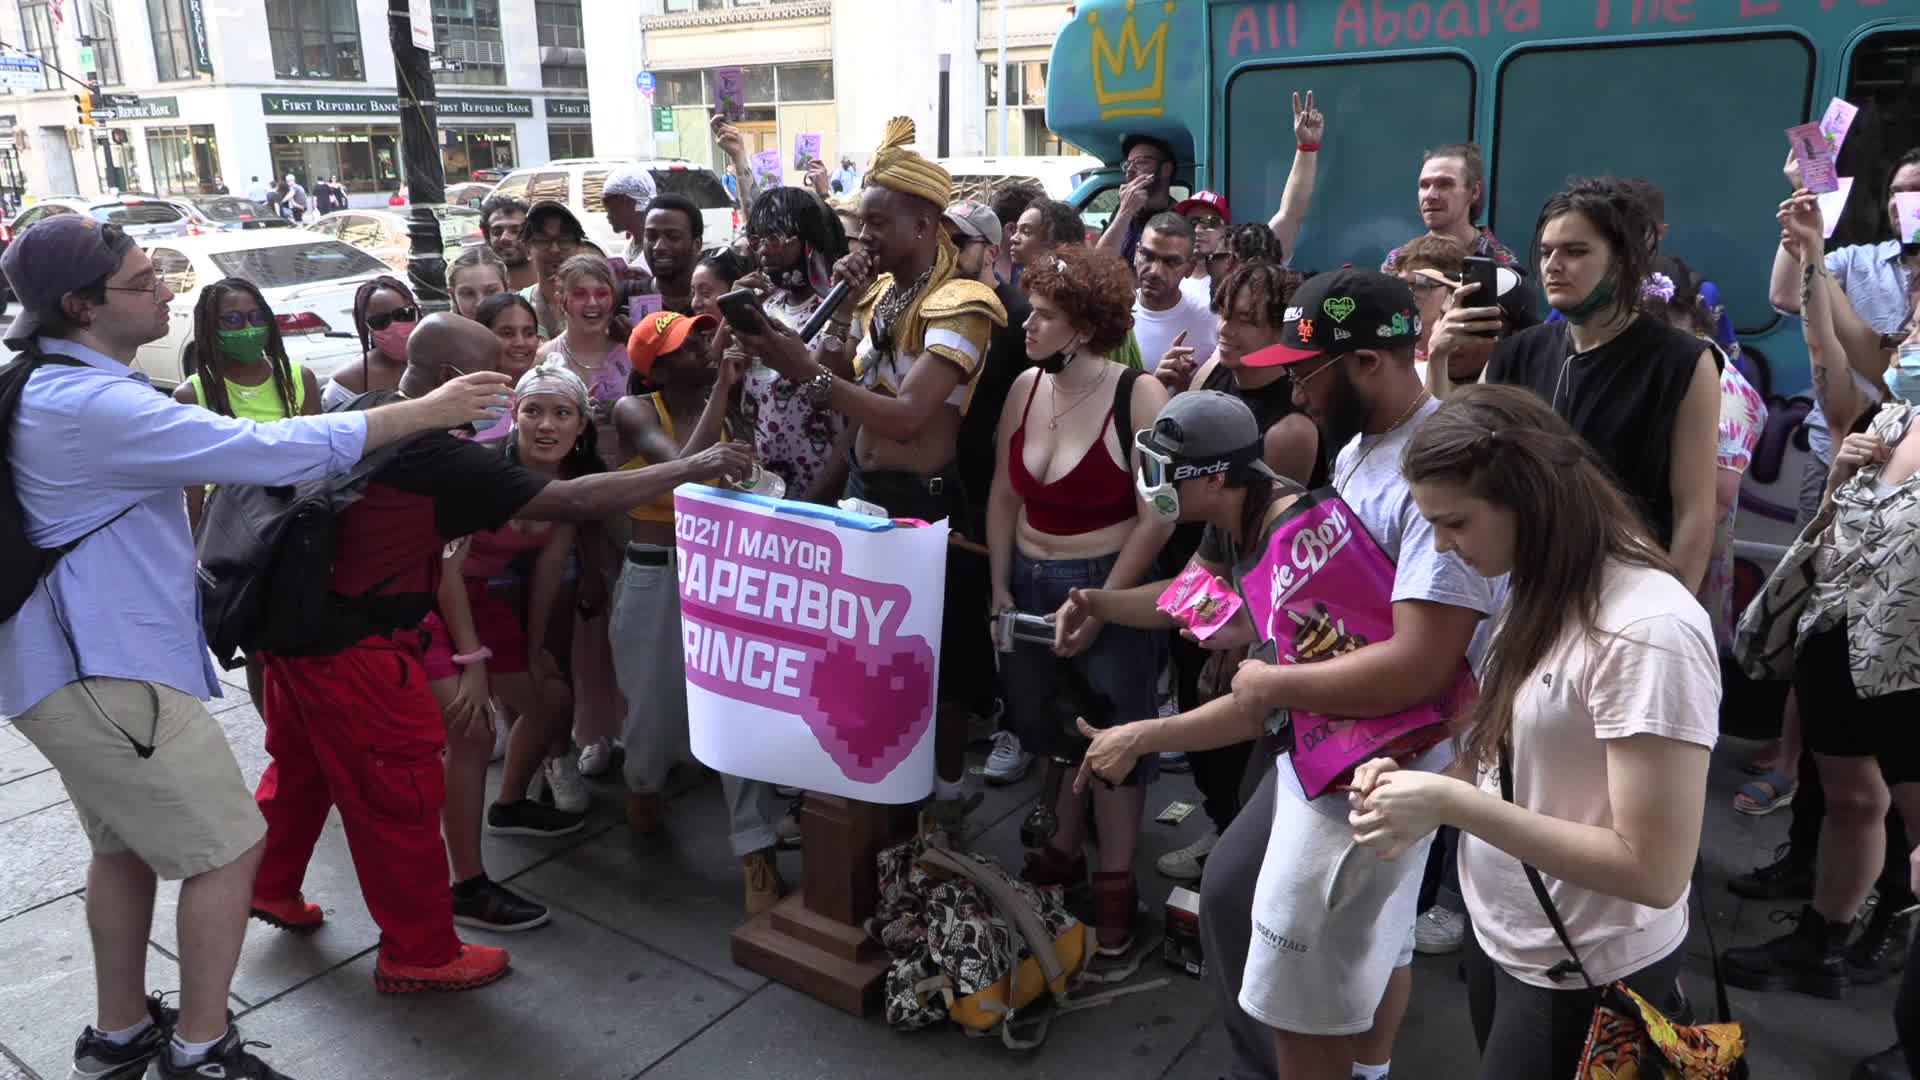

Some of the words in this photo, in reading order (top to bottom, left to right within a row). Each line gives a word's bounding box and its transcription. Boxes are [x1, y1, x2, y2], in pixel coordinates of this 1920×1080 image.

[1227, 3, 1298, 57] All
[281, 99, 312, 111] FIRST
[316, 99, 367, 112] REPUBLIC
[369, 100, 399, 112] BANK
[461, 102, 504, 113] REPUBLIC
[506, 103, 530, 113] BANK
[559, 104, 580, 113] FIRST
[1174, 460, 1231, 481] Birdz
[674, 511, 720, 548] 2021
[738, 527, 832, 576] MAYOR
[681, 615, 807, 698] RINCE
